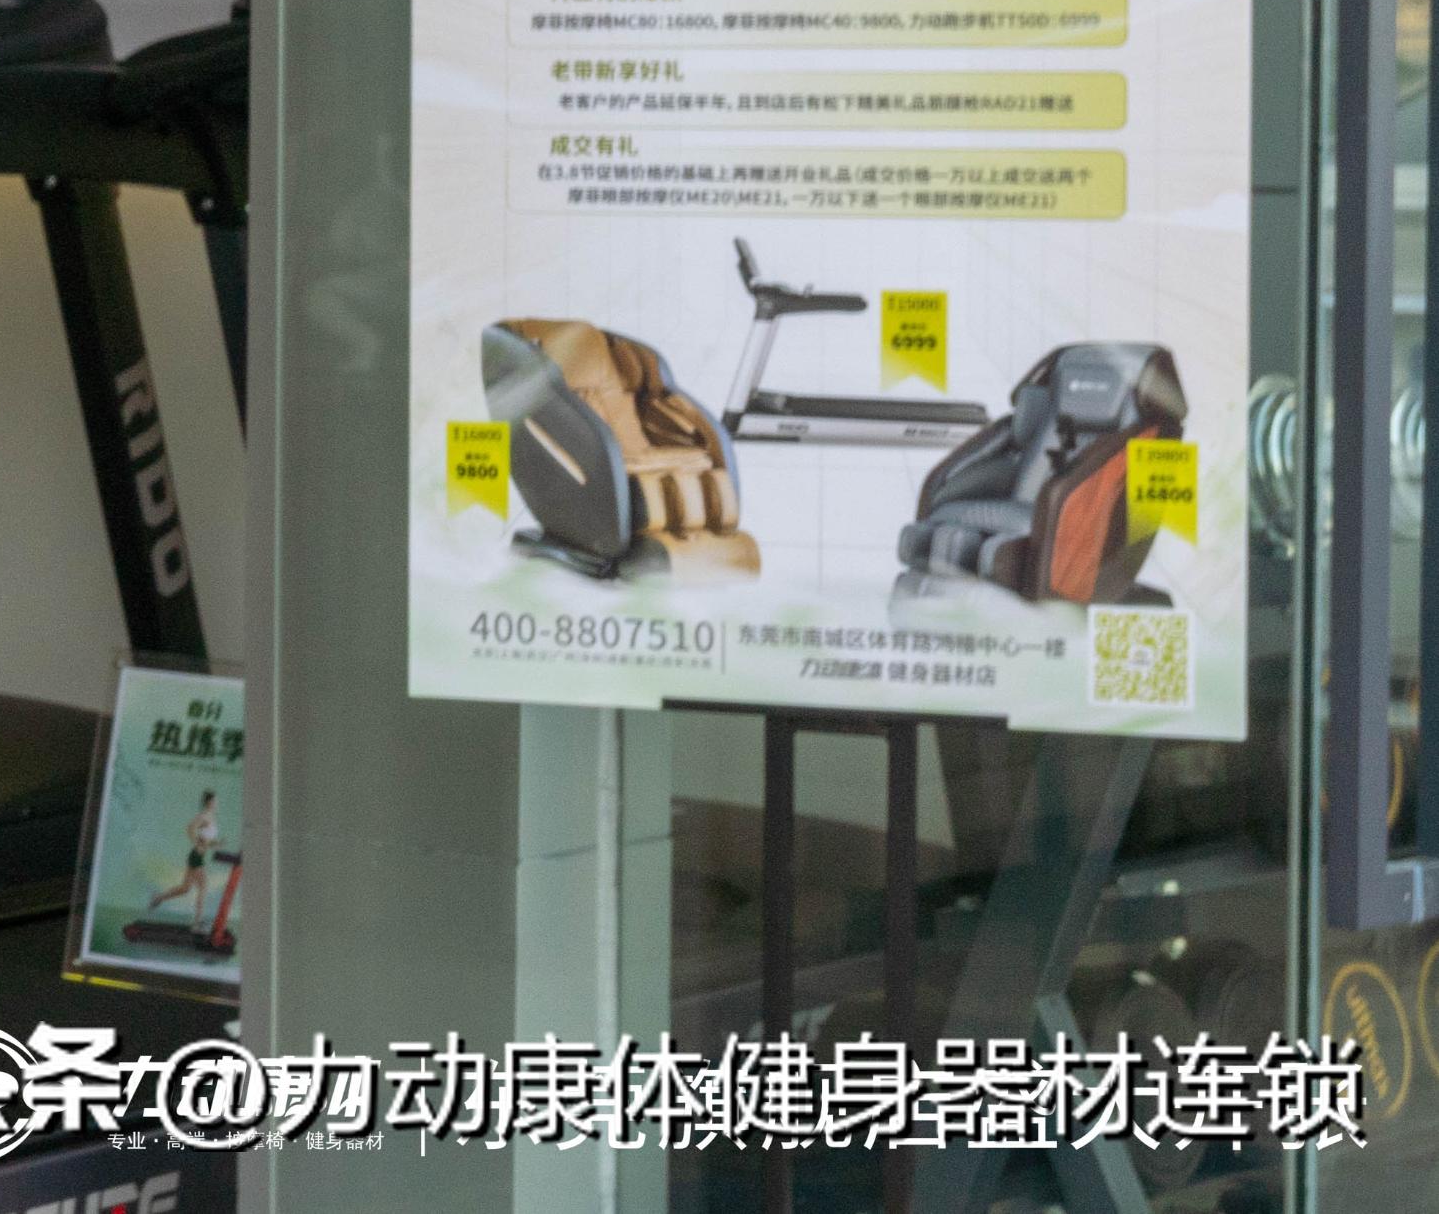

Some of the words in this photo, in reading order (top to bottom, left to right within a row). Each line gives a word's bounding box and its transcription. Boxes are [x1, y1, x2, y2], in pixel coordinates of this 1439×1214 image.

[551, 60, 684, 82] 老带新享好礼
[550, 135, 639, 156] 成交有礼
[891, 334, 937, 351] 6999
[114, 355, 190, 597] RIDO
[456, 463, 499, 480] 9800
[471, 612, 715, 653] 400-8807510
